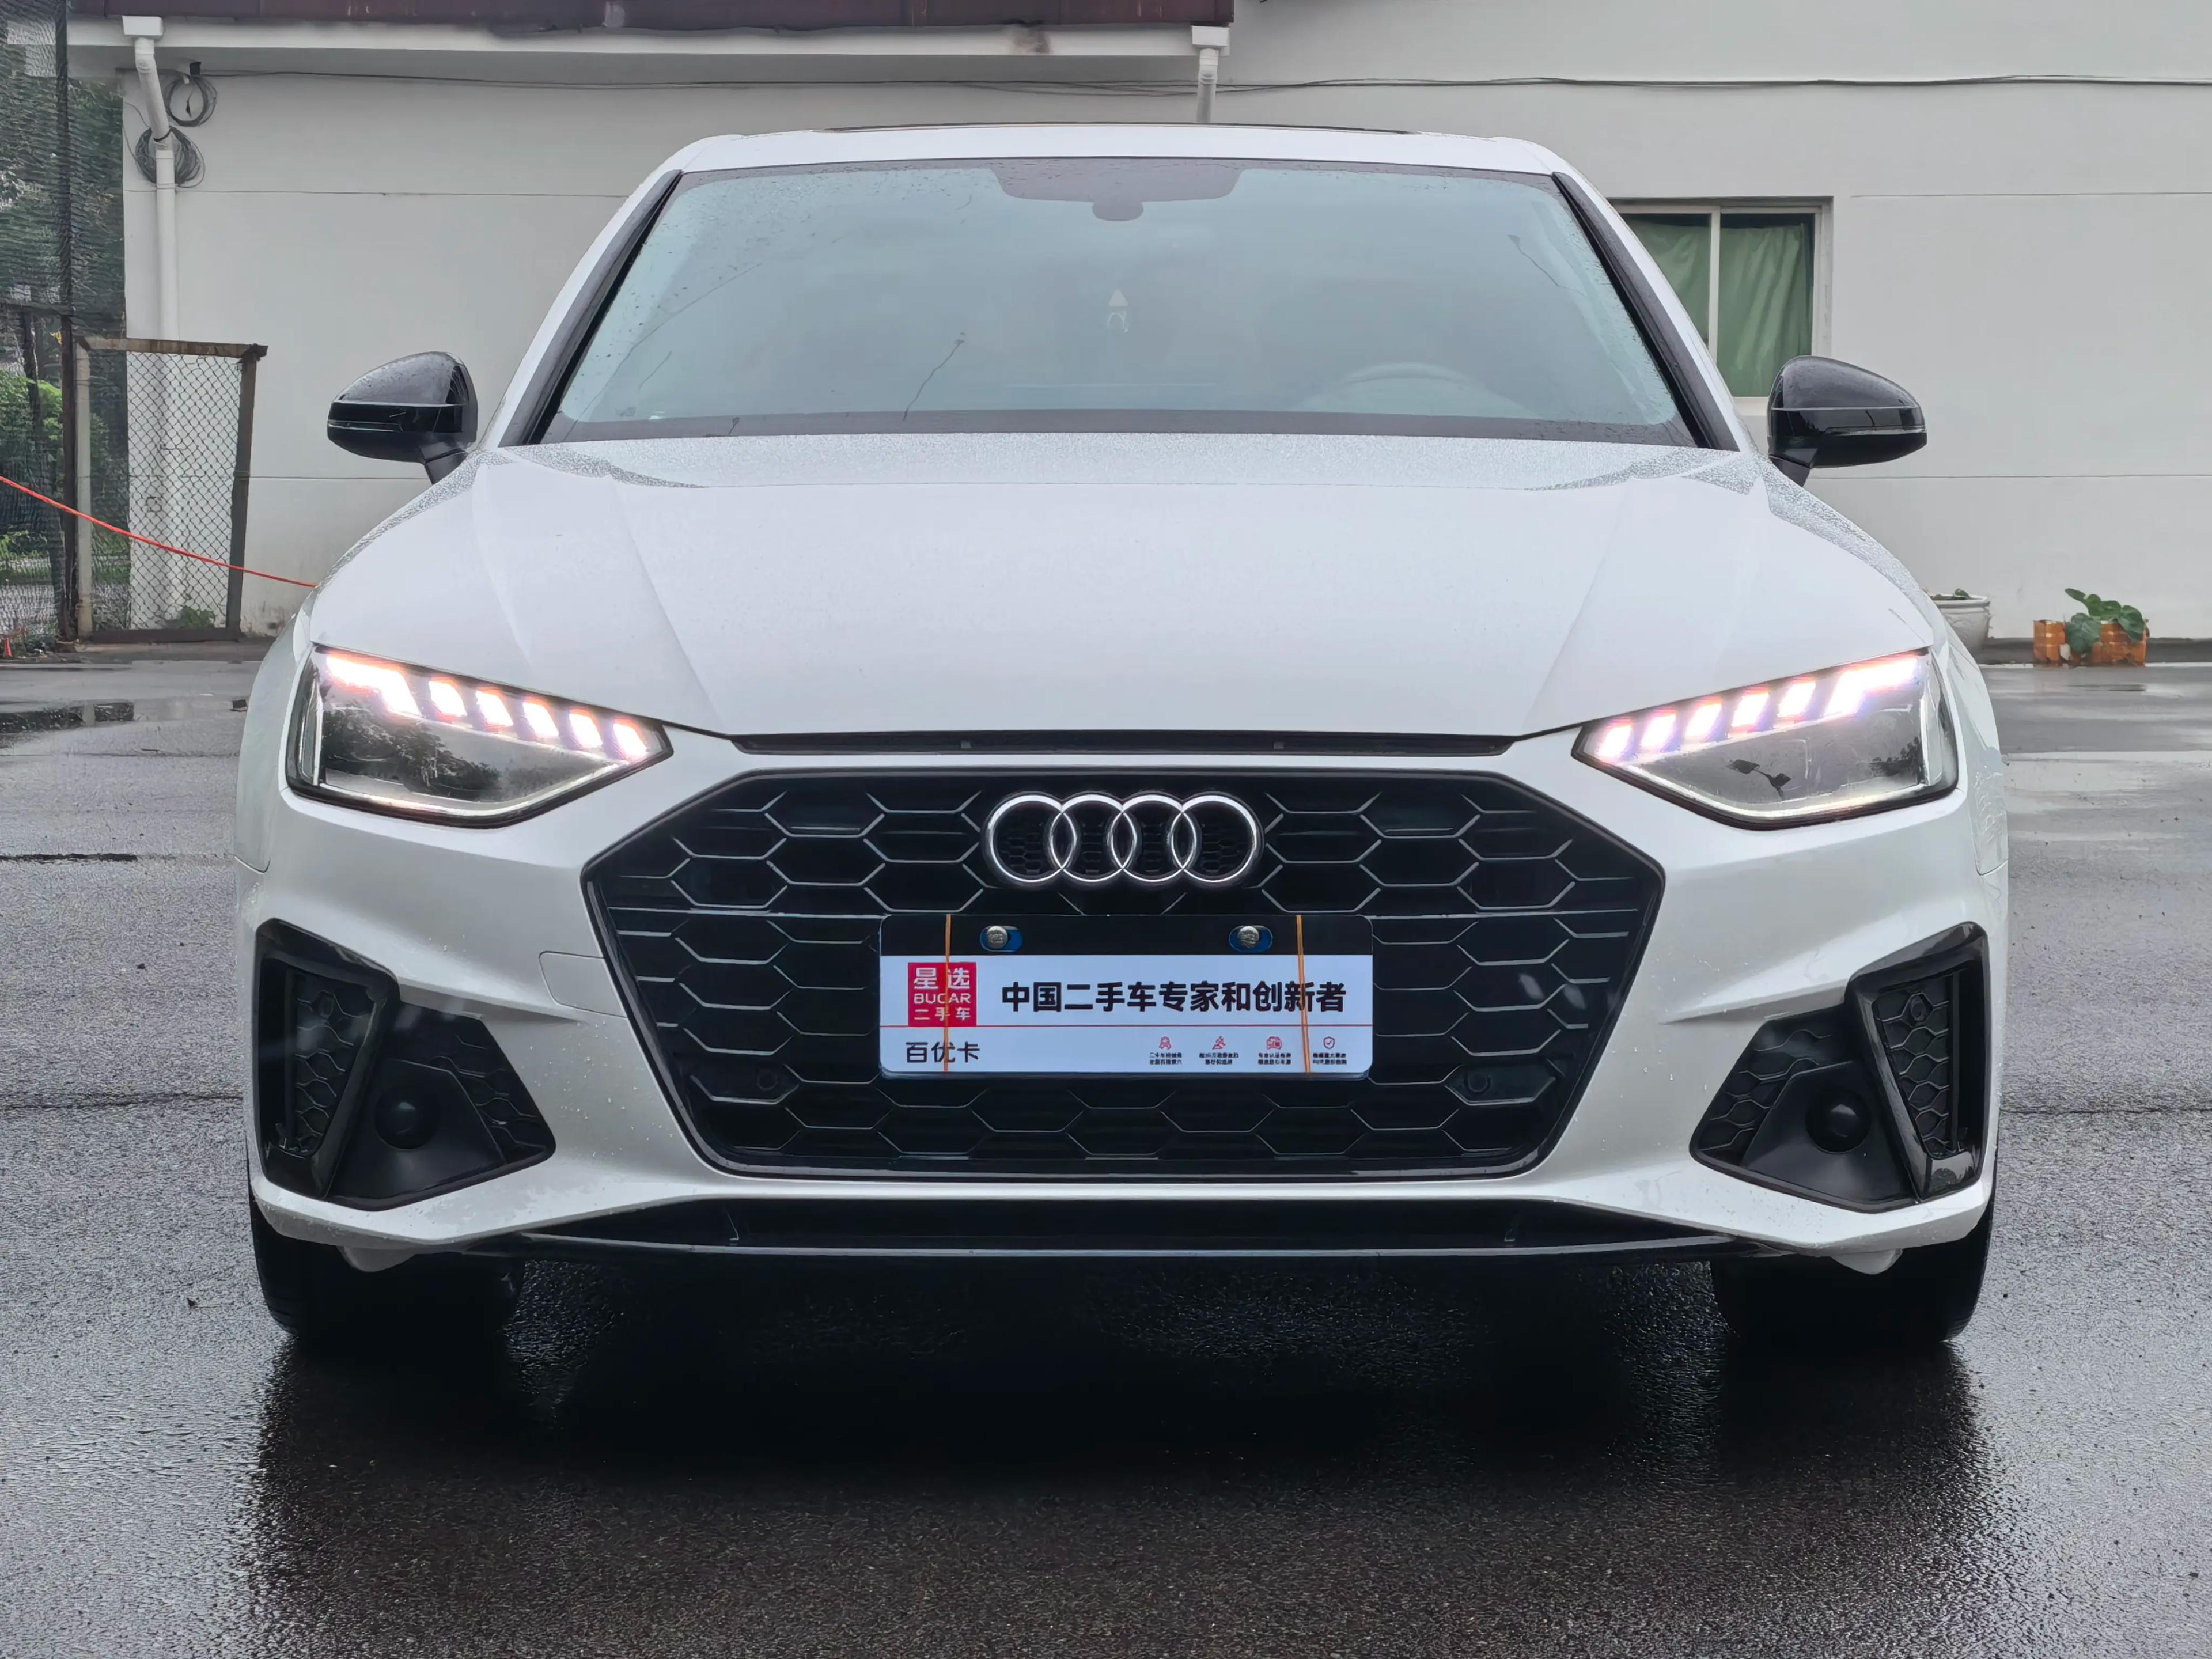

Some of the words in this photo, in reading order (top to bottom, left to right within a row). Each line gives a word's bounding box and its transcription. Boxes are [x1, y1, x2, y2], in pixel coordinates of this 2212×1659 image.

[914, 967, 970, 990] 星选
[914, 993, 971, 1004] BUCAR
[1002, 980, 1346, 1012] 中国二手车专家和创新者
[914, 1007, 971, 1021] 二手车
[906, 1041, 980, 1063] 百优卡
